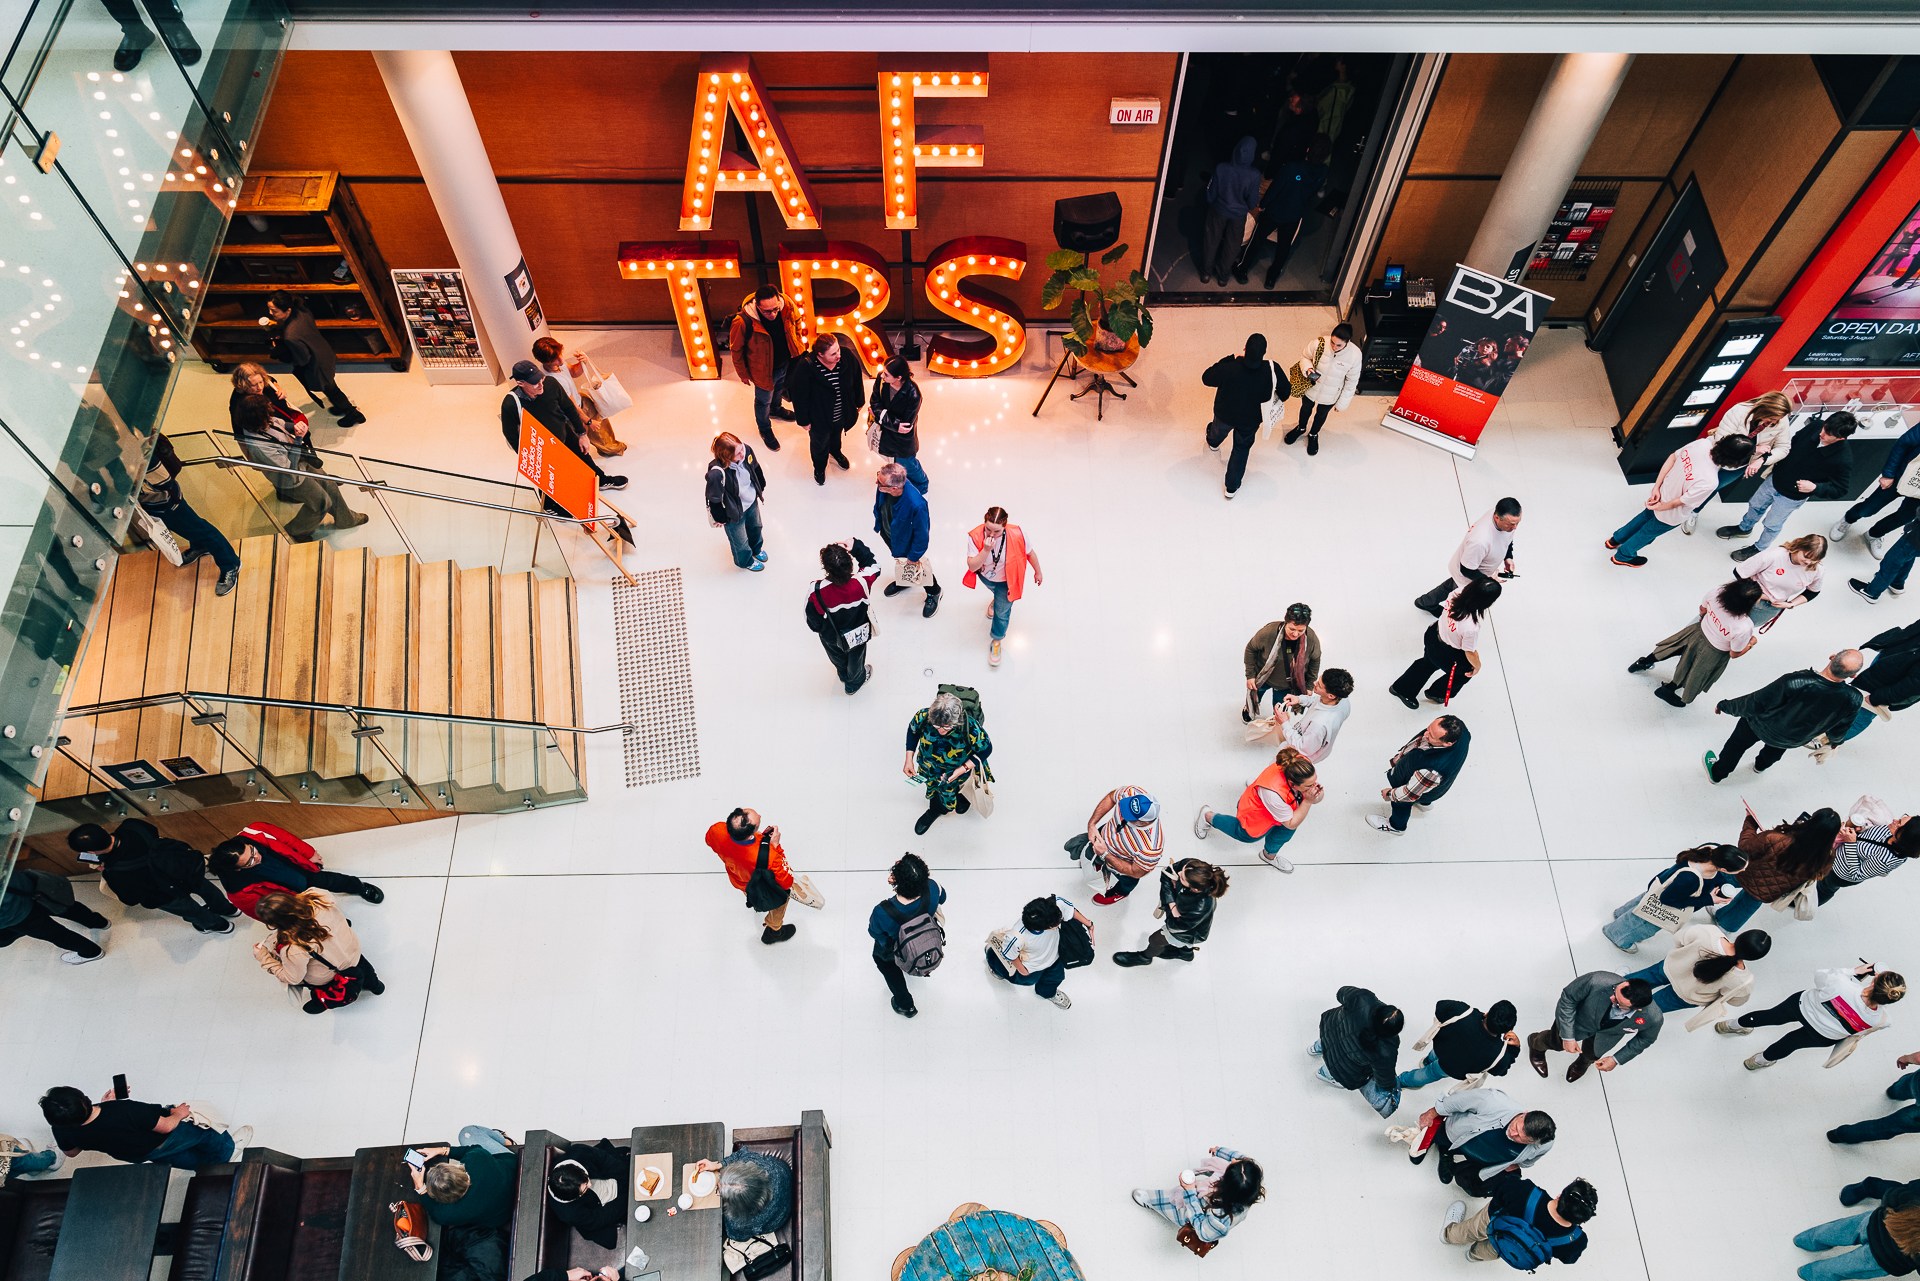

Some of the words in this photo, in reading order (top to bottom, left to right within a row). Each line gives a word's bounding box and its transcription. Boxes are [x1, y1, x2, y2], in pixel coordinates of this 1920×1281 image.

[1117, 110, 1132, 122] ON
[1135, 110, 1153, 122] AIR
[1445, 267, 1534, 333] BA
[1828, 322, 1887, 334] OPEN
[1885, 322, 1920, 335] DAY
[1394, 406, 1439, 429] AFTRS
[520, 447, 528, 473] Radio
[526, 446, 536, 479] Studios
[533, 436, 545, 484] Podcasting
[1680, 449, 1695, 481] CREW
[547, 469, 555, 495] Level
